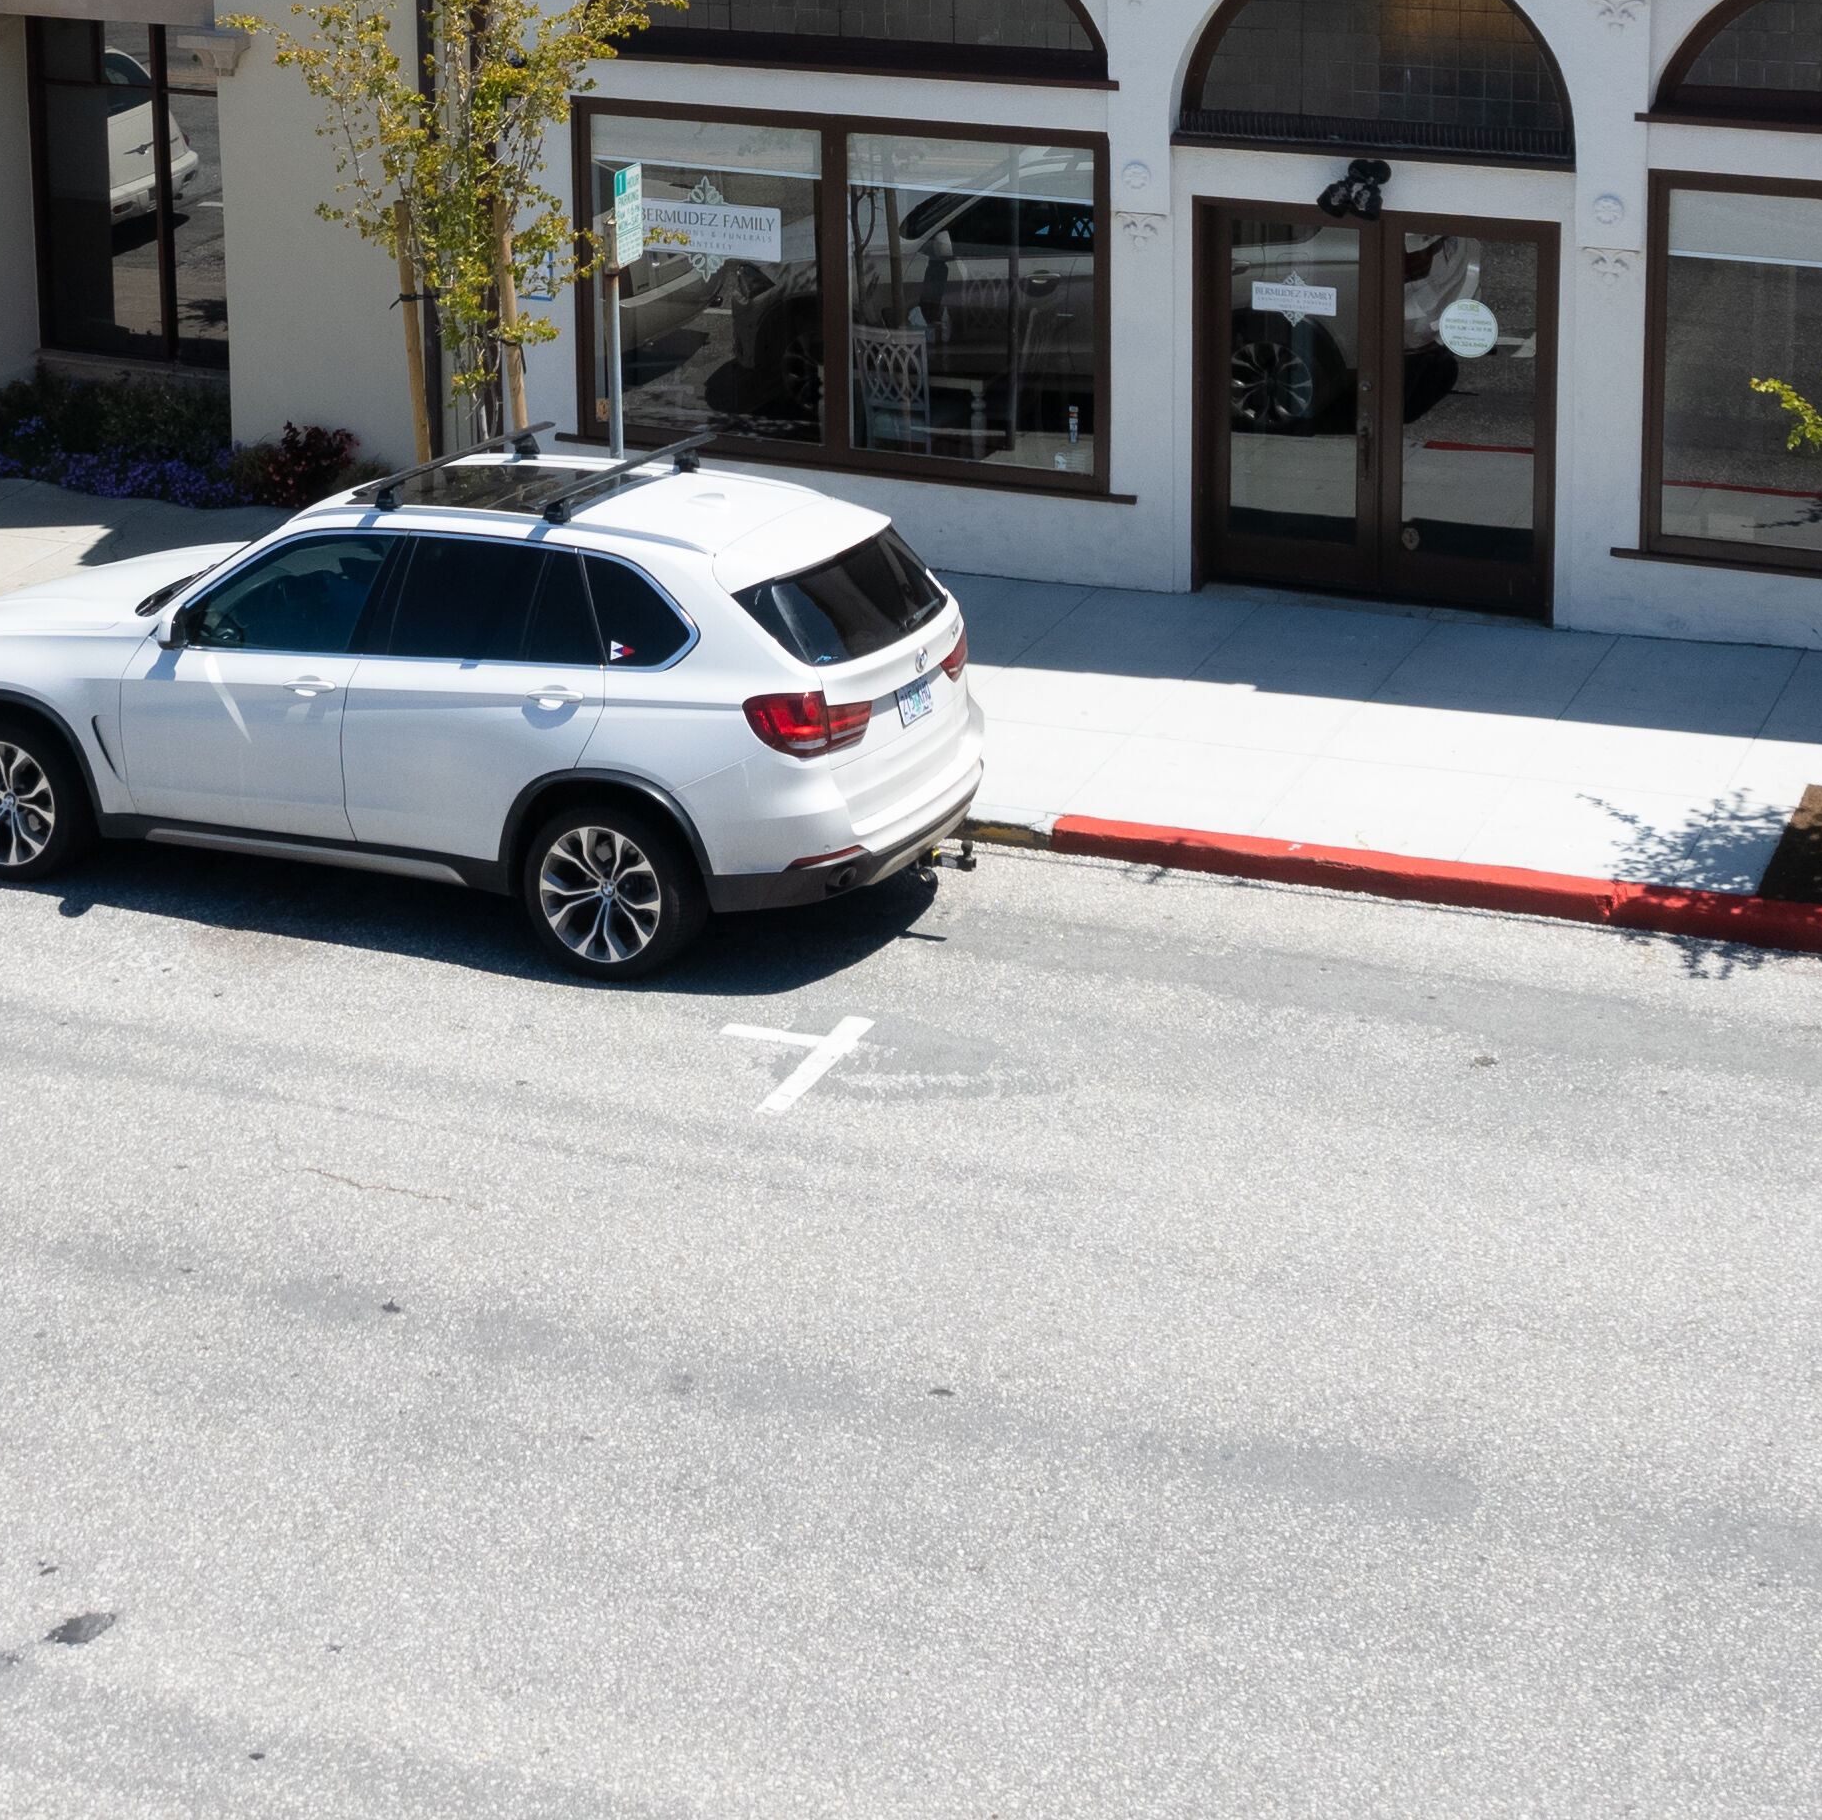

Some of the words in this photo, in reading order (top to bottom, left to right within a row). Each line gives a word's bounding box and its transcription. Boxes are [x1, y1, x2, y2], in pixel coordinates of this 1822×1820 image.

[618, 189, 640, 208] PARKING
[723, 214, 776, 233] FAMILY
[688, 240, 733, 251] ONTEREY
